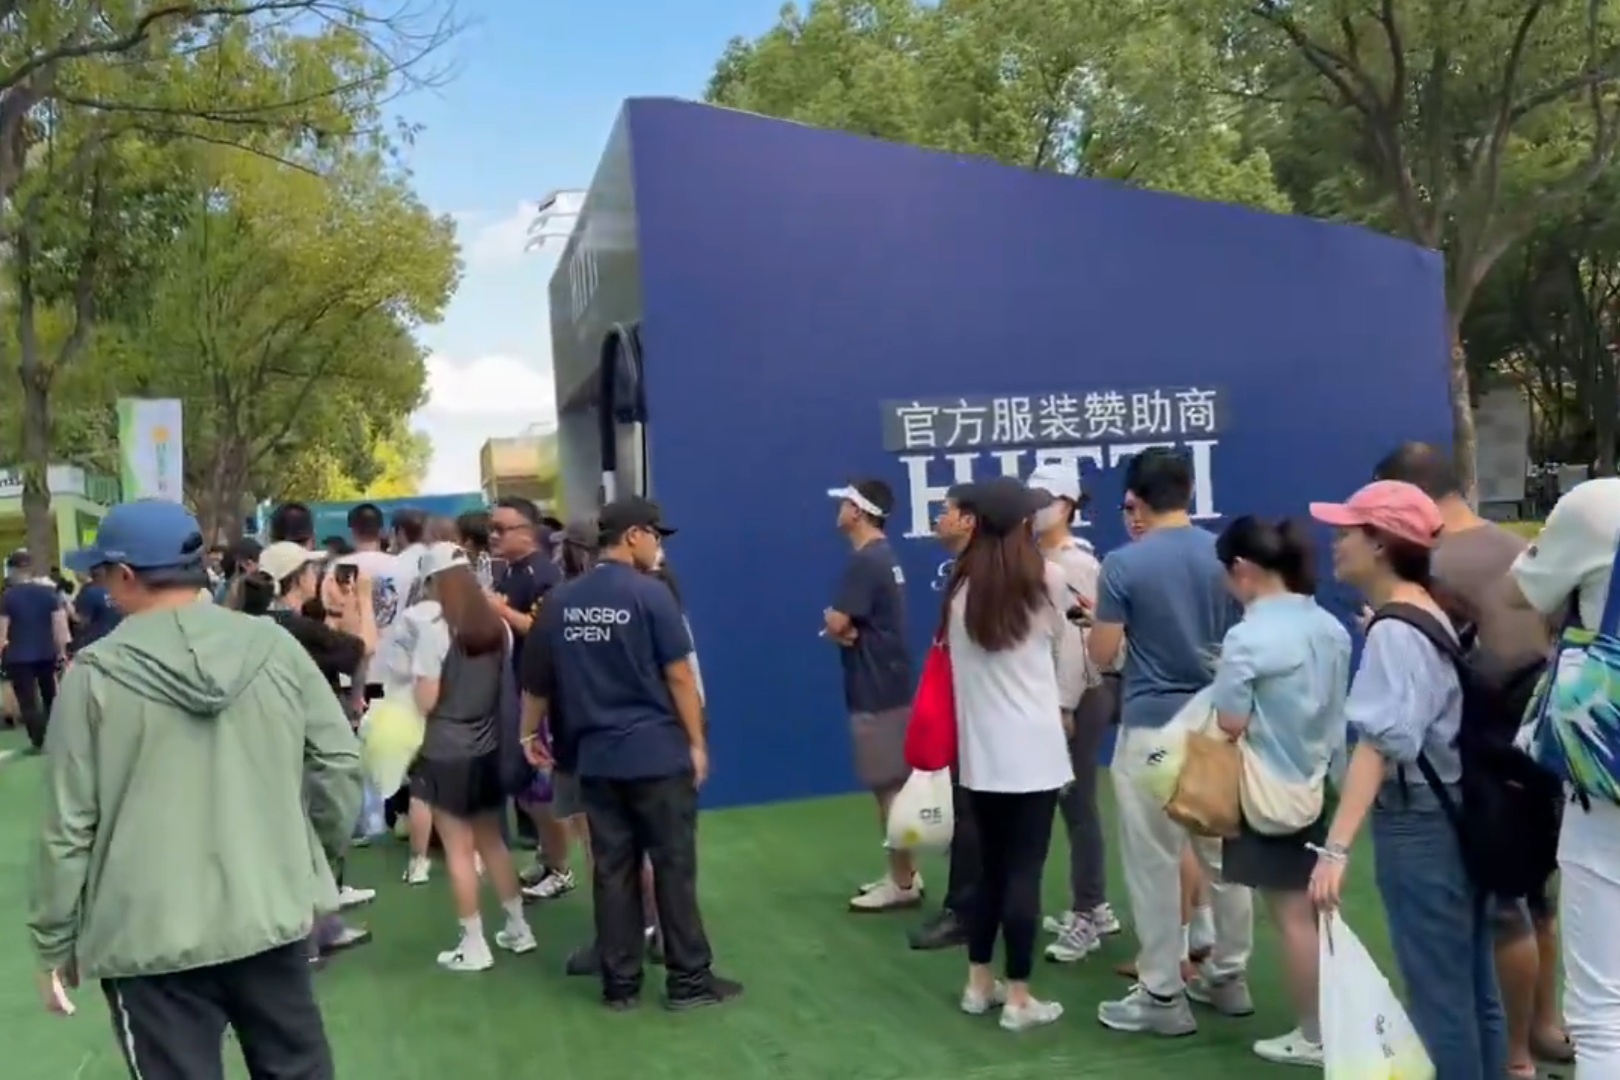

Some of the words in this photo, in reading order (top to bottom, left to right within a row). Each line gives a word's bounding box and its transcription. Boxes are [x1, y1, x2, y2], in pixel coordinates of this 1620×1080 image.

[896, 387, 1217, 448] 官方服装赞助商
